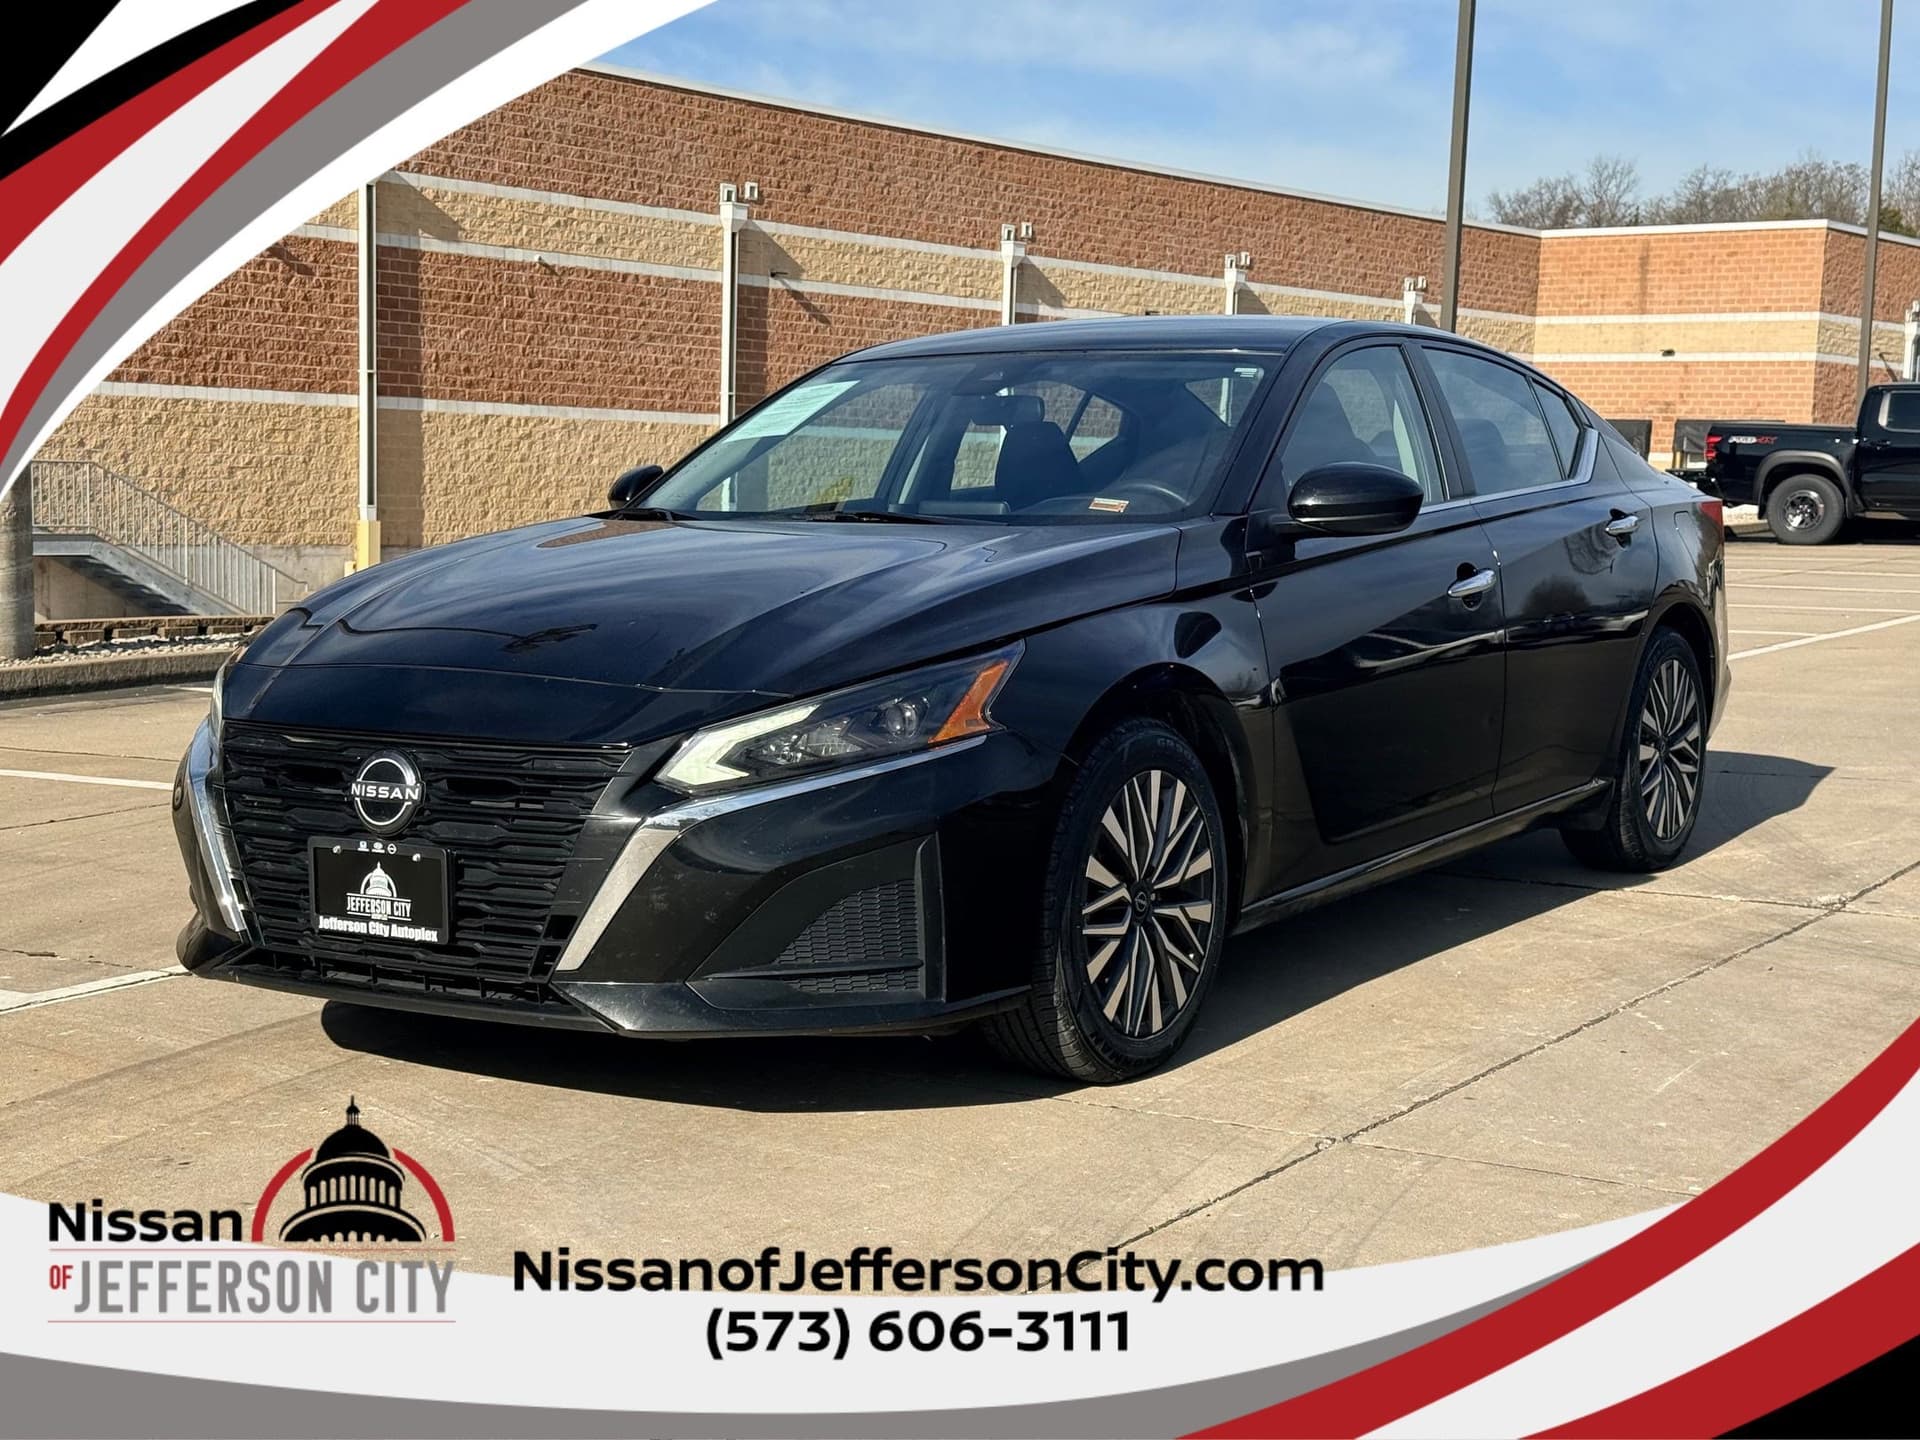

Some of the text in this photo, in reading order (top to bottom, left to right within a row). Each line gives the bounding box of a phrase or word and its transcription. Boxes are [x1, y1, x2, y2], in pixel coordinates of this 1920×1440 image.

[351, 783, 420, 801] NISSAN
[346, 896, 411, 917] JEFFERSON CITY
[319, 915, 438, 942] Jefferson City Autoplex
